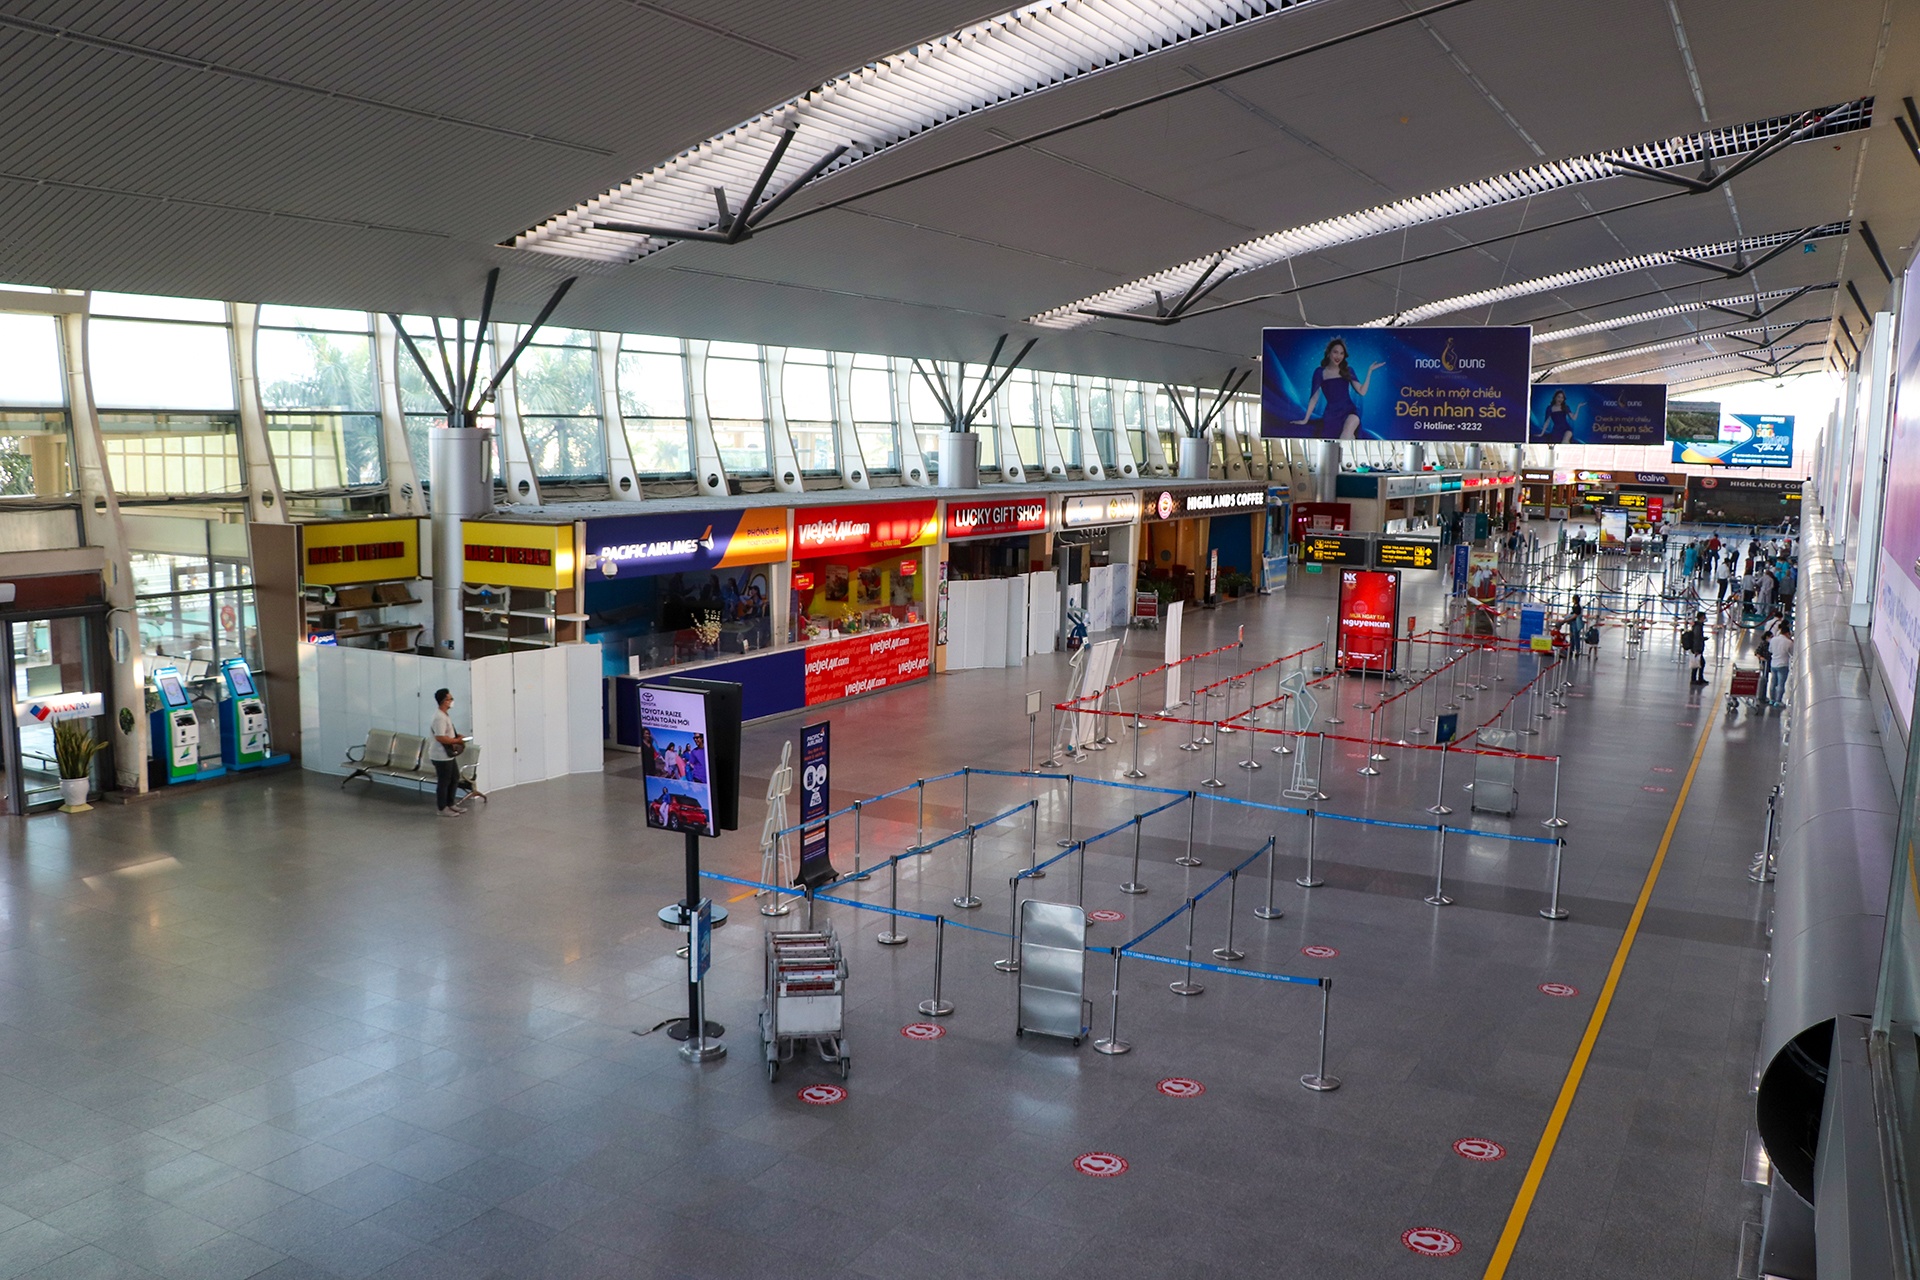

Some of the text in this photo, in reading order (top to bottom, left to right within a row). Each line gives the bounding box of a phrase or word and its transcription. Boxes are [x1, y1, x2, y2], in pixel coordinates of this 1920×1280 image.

[1400, 386, 1501, 399] Check in một chiều
[1394, 401, 1506, 418] Đến nhan sắc
[1614, 424, 1636, 432] nhan
[1638, 474, 1666, 482] tealive
[1187, 492, 1264, 510] HIGHLANDS COFFEE
[956, 504, 1042, 527] LUCKY GIFT SHOP
[356, 541, 404, 561] VIETNAM
[601, 540, 698, 561] PACIFIC AIRLINES
[1238, 969, 1265, 978] CORPORATION
